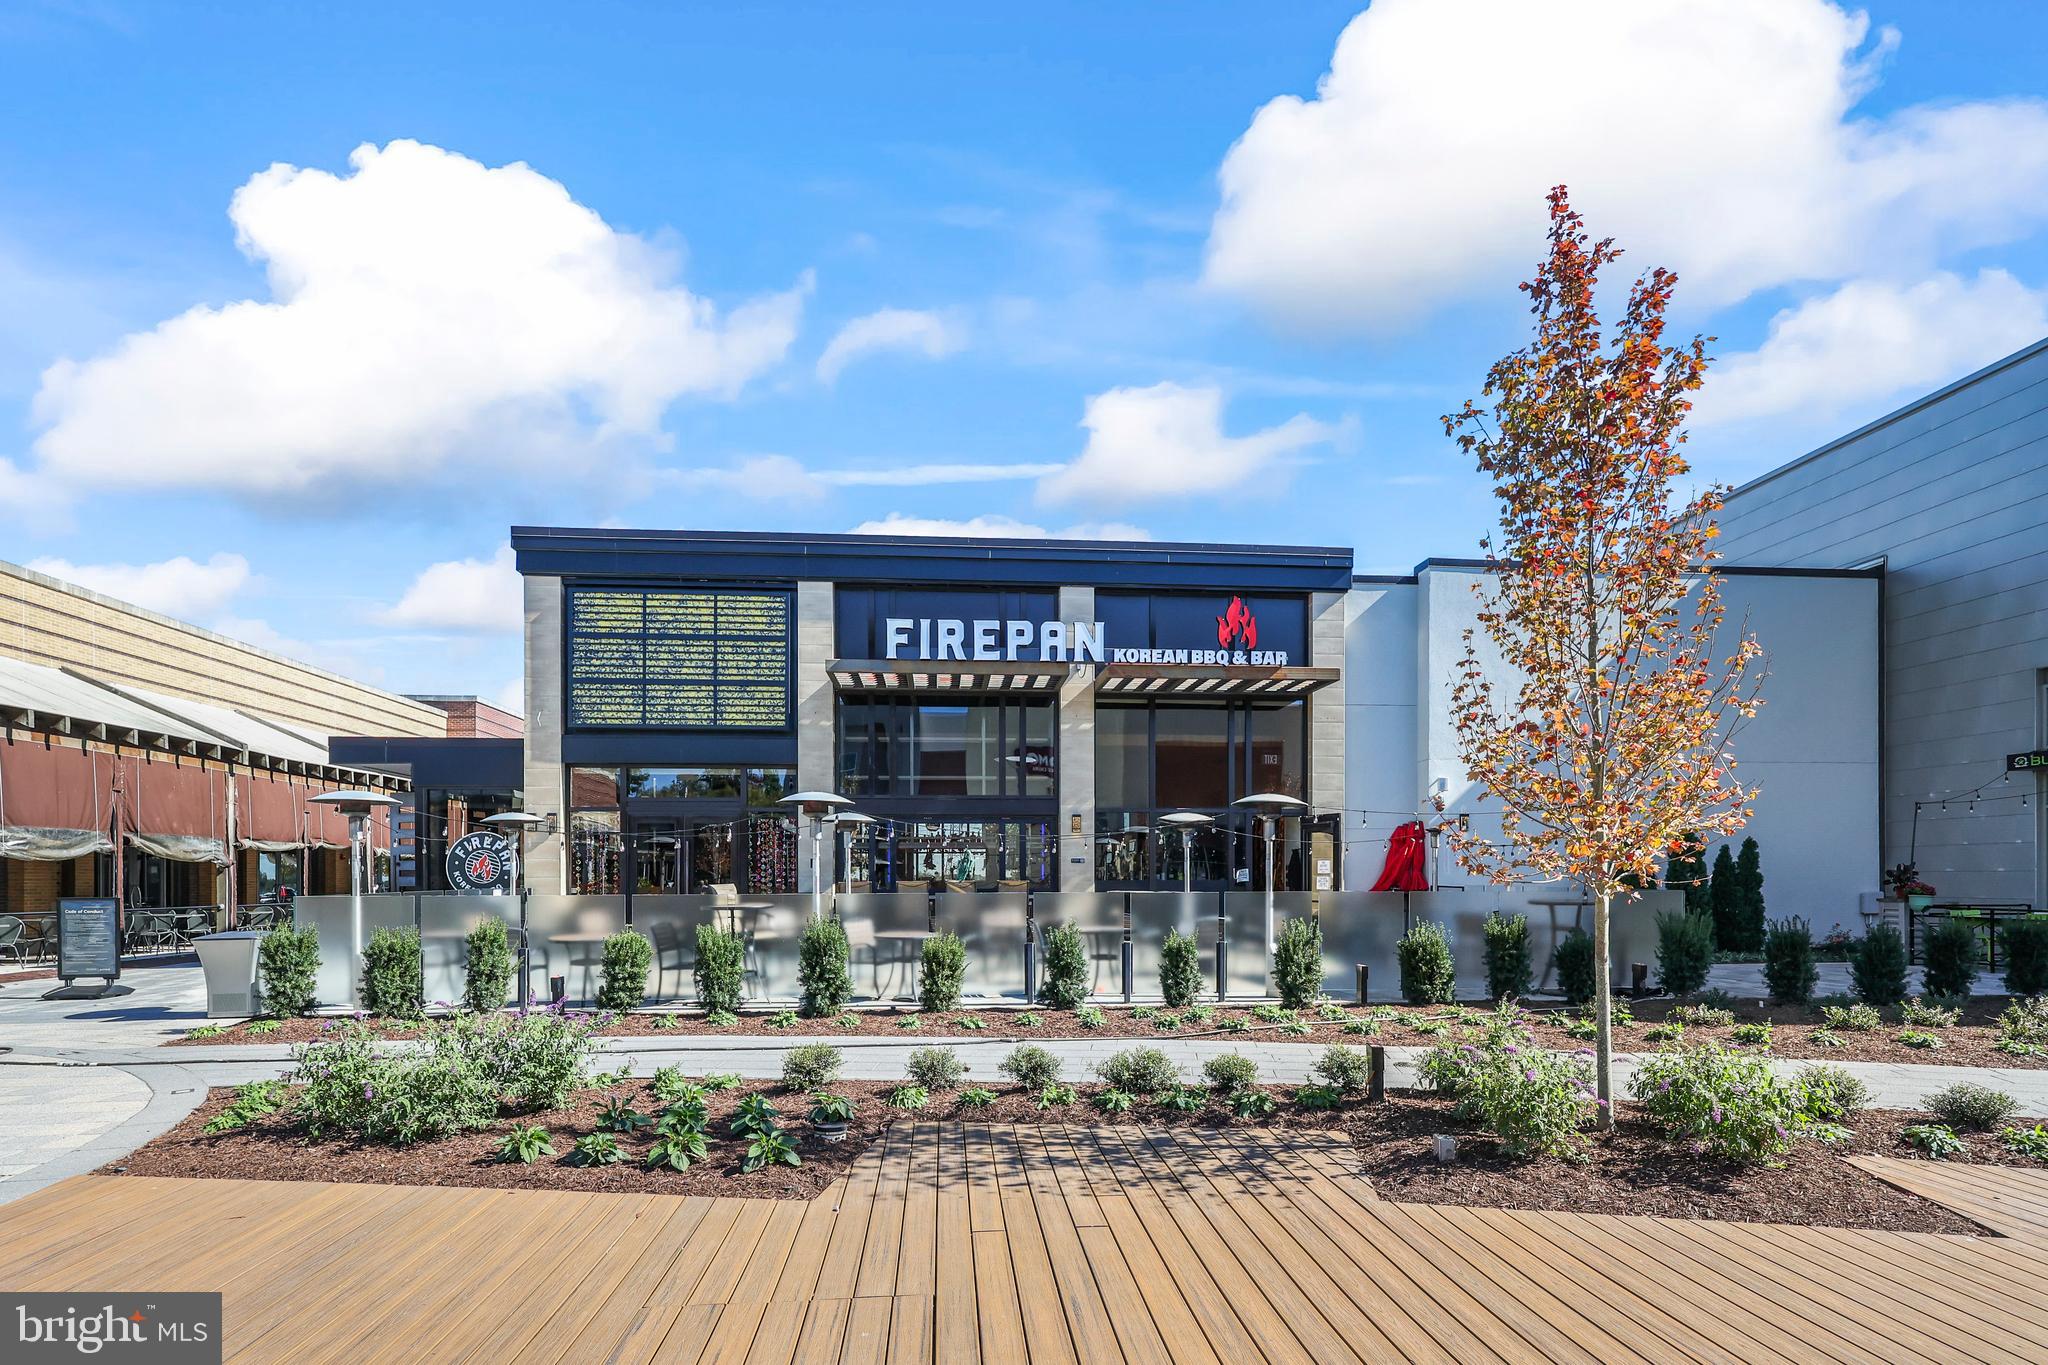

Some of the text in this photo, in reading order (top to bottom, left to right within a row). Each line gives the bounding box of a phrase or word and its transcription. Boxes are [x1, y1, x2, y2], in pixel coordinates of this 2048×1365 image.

[885, 618, 1105, 662] FIREPAN
[1113, 648, 1288, 666] KOREAN BBQ & BAR
[455, 836, 512, 871] FIREPAN
[453, 870, 476, 890] KORE
